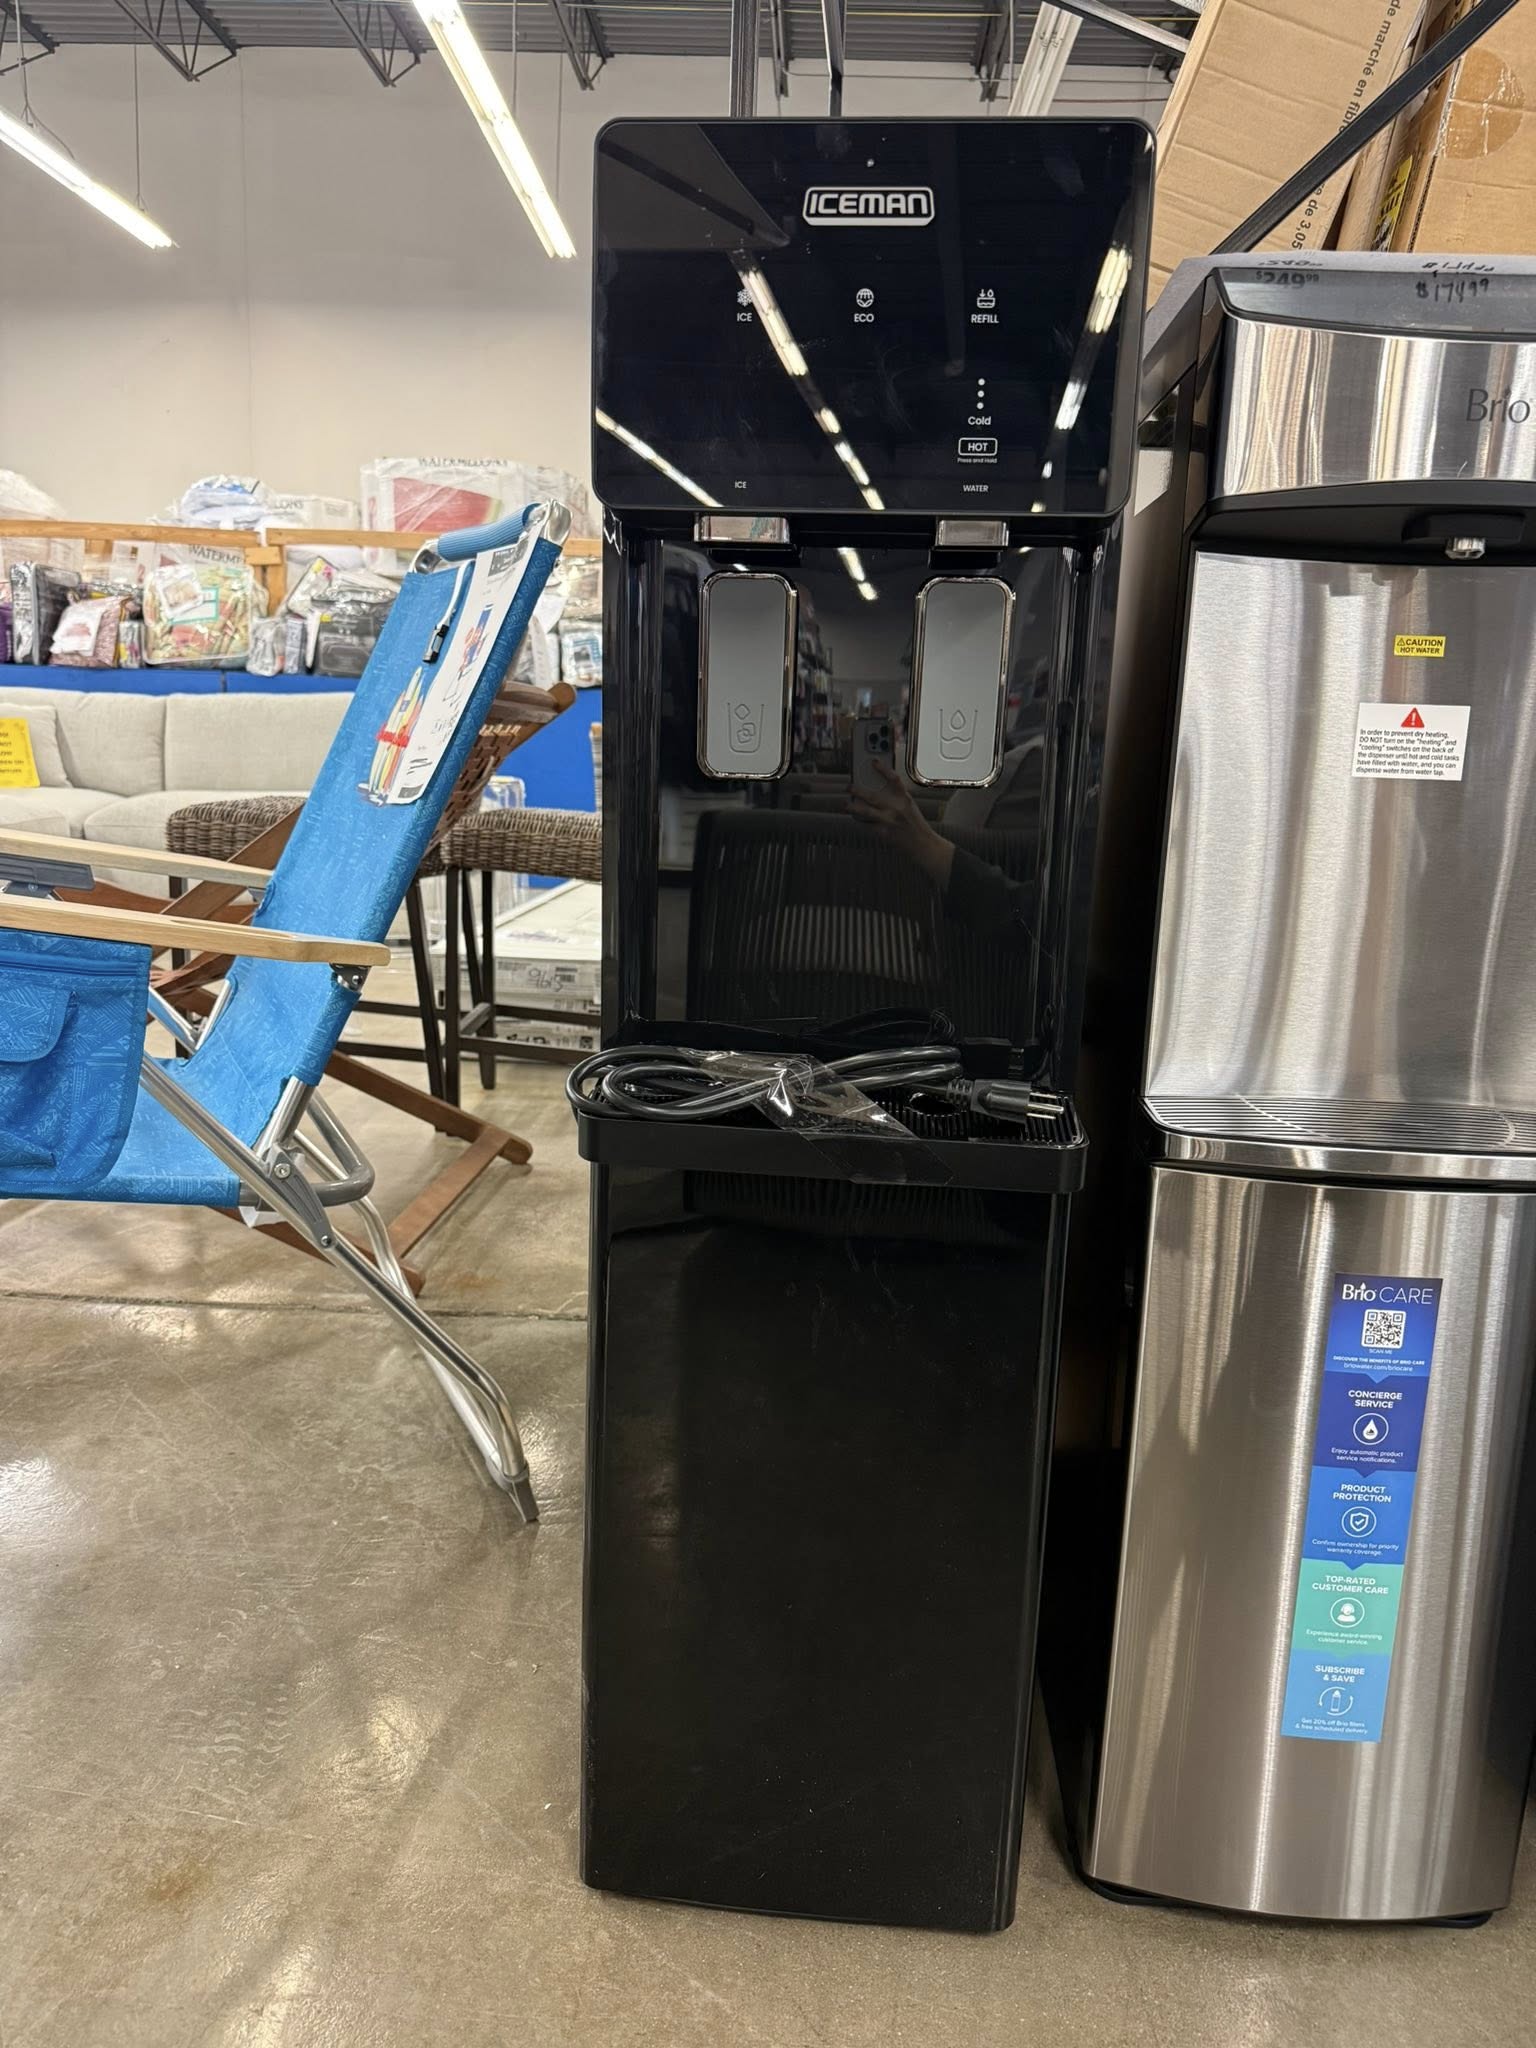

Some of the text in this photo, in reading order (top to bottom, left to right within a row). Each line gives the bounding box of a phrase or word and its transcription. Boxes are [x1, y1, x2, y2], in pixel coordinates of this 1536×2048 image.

[1362, 20, 1392, 77] marché
[1353, 79, 1367, 98] en
[808, 193, 929, 215] ICEMAN
[1305, 199, 1318, 216] de
[736, 312, 753, 323] ICE
[853, 313, 875, 323] ECO
[971, 314, 999, 324] REFILL
[1466, 386, 1530, 424] Brio
[967, 416, 992, 425] Cold
[968, 442, 988, 452] HOT
[734, 480, 747, 488] ICE
[963, 485, 989, 493] WATER
[1405, 639, 1443, 647] CAUTION
[1391, 730, 1414, 738] prevent
[1356, 766, 1381, 774] dispense
[1342, 1282, 1433, 1305] Brio CARE
[1348, 1390, 1403, 1400] CONCIERGE
[1354, 1399, 1394, 1409] SERVICE
[1331, 1447, 1348, 1455] Enjoy
[1341, 1484, 1386, 1494] PRODUCT
[1332, 1492, 1392, 1503] PROTECTION
[1312, 1538, 1336, 1546] Confirm
[1337, 1541, 1368, 1549] ownership
[1378, 1543, 1400, 1551] priority
[1327, 1547, 1353, 1555] warranty
[1325, 1575, 1376, 1585] TOP-RATED
[1312, 1583, 1389, 1595] CUSTOMER CARE
[1306, 1629, 1339, 1637] Experience
[1315, 1665, 1365, 1675] SUBSCRIBE
[1331, 1674, 1355, 1683] SAVE
